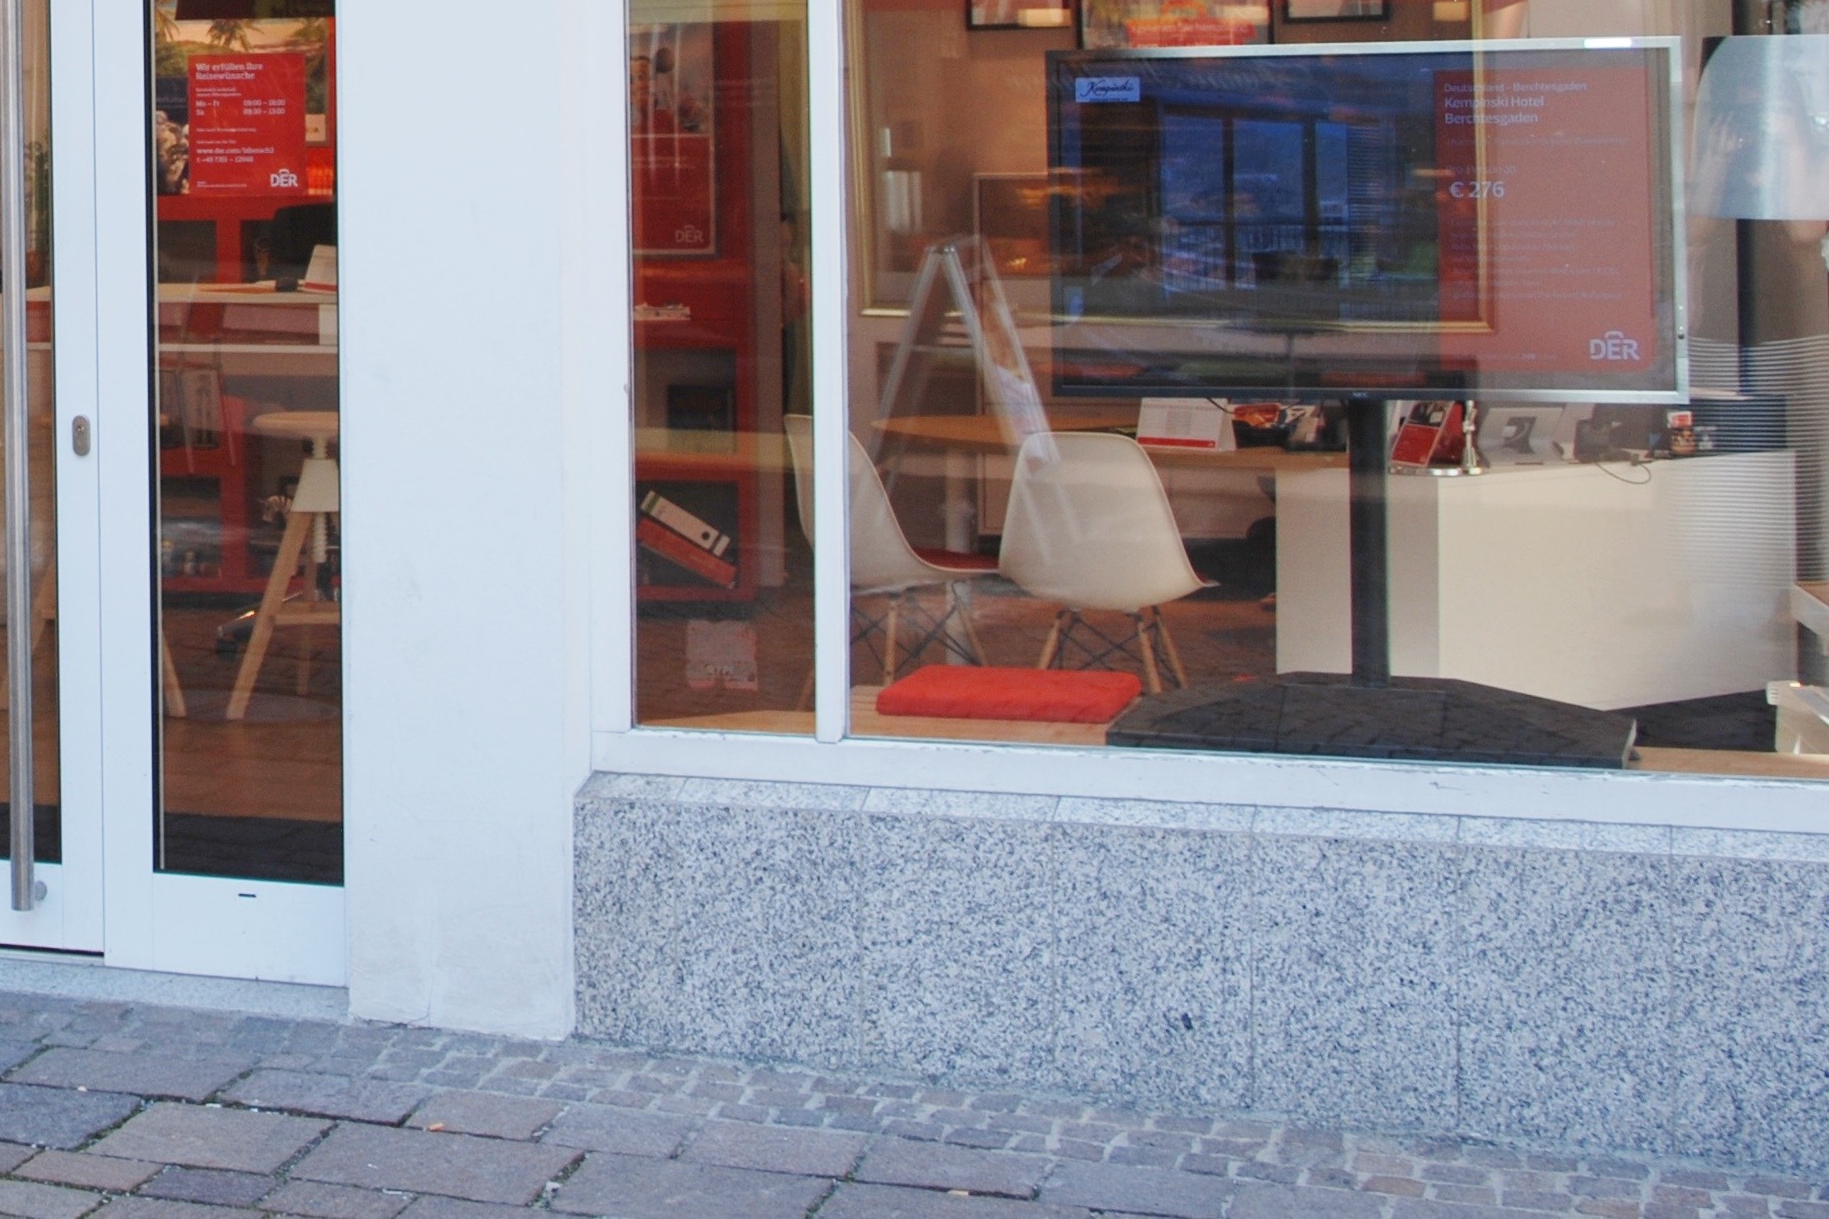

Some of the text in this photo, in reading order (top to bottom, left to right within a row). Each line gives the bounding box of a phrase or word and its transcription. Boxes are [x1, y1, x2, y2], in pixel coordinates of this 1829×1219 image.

[269, 170, 299, 188] DER
[1469, 181, 1505, 198] 276
[1589, 335, 1641, 360] DER
